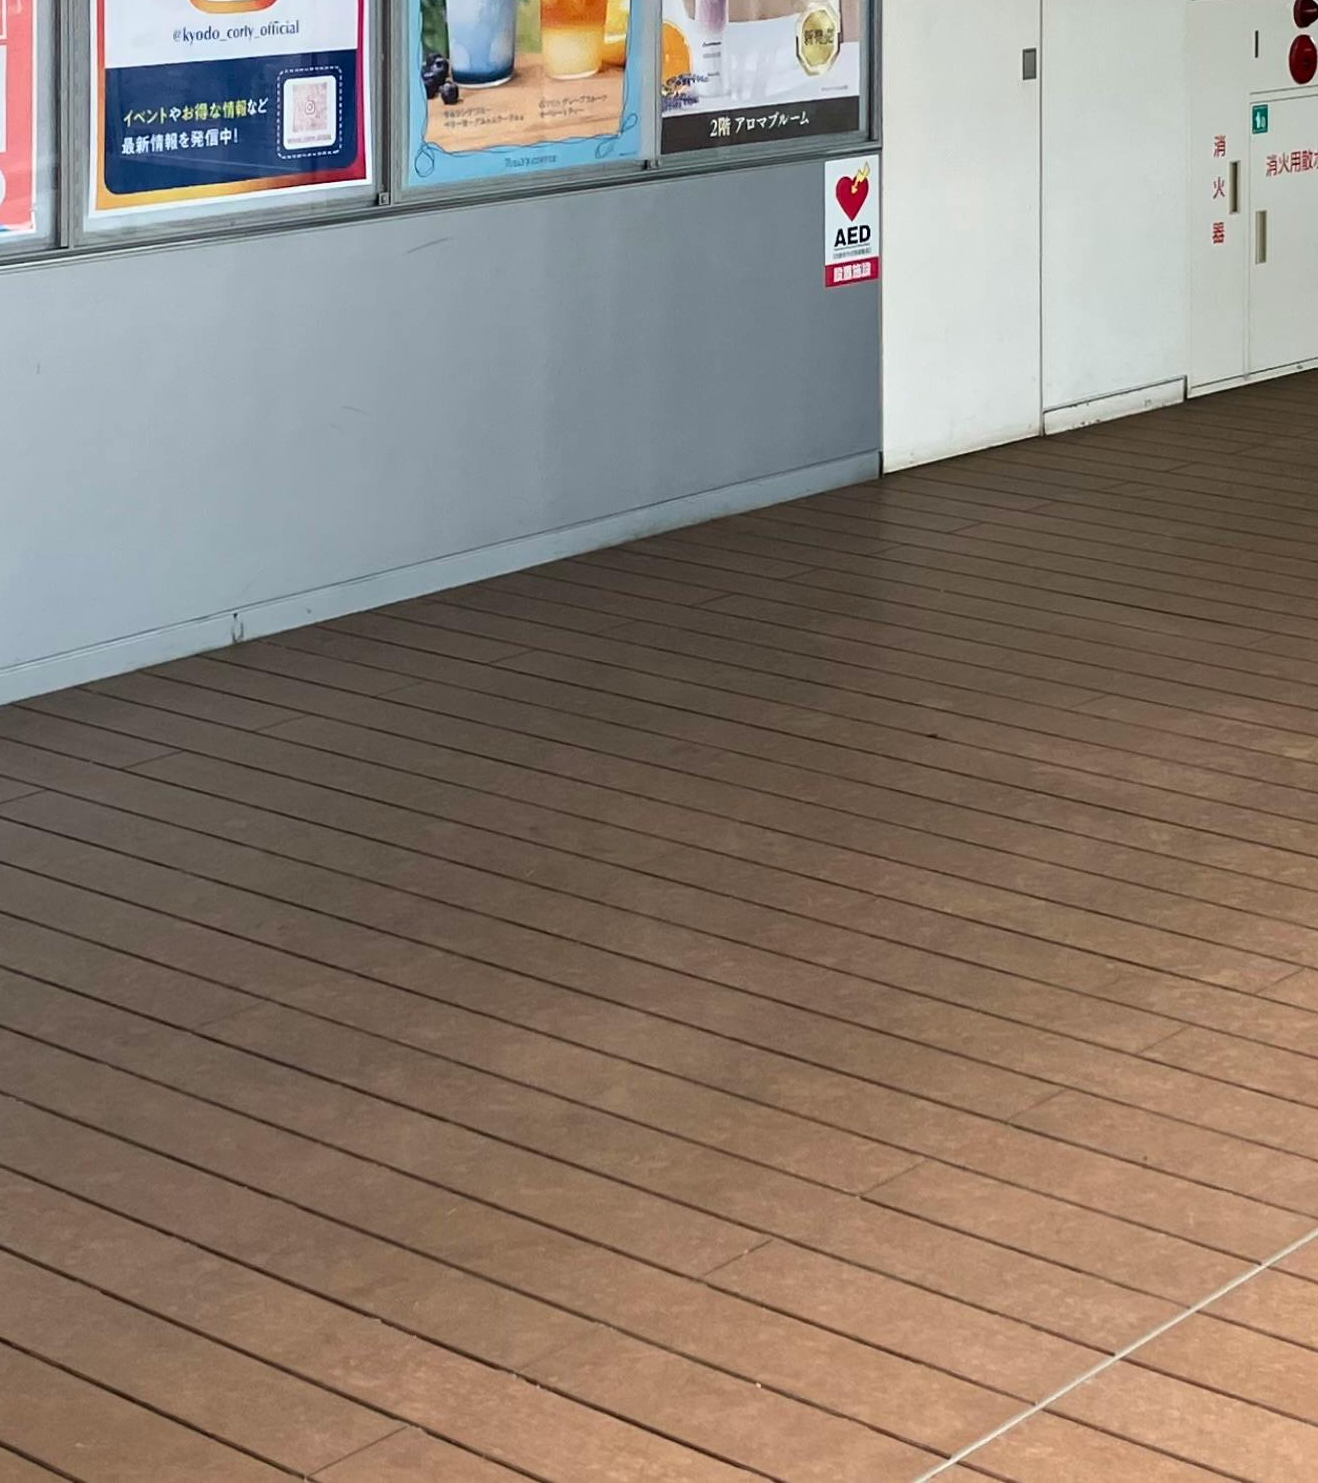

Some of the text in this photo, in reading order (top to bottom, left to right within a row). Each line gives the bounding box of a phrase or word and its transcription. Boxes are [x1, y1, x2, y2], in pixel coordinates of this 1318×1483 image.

[172, 20, 301, 46] @kyodo_corty_official
[123, 97, 269, 127] イベントやお得な情報など
[709, 110, 810, 138] 2階 アロマブルーム
[834, 224, 872, 248] AED
